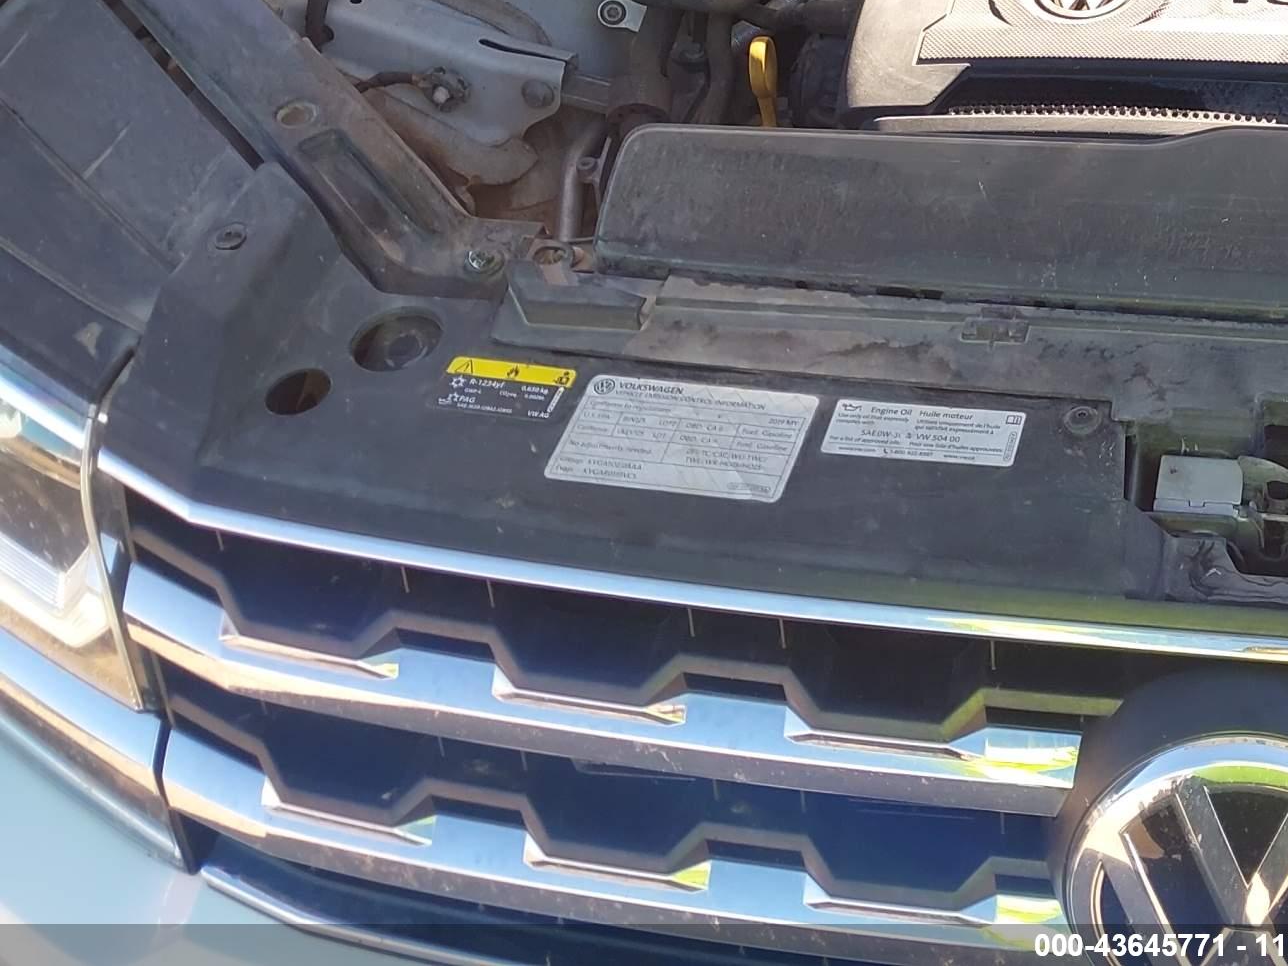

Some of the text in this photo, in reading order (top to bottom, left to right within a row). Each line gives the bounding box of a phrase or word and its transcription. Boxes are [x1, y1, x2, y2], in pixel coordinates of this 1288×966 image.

[619, 381, 684, 395] VOLKSWAGEN
[459, 395, 477, 404] PAG
[714, 398, 766, 411] INFORMATION
[527, 410, 540, 418] VW
[871, 406, 913, 416] Engine Oil
[919, 409, 973, 420] Huile moteur
[917, 433, 931, 441] VW
[931, 434, 947, 442] 504
[949, 435, 960, 443] 00
